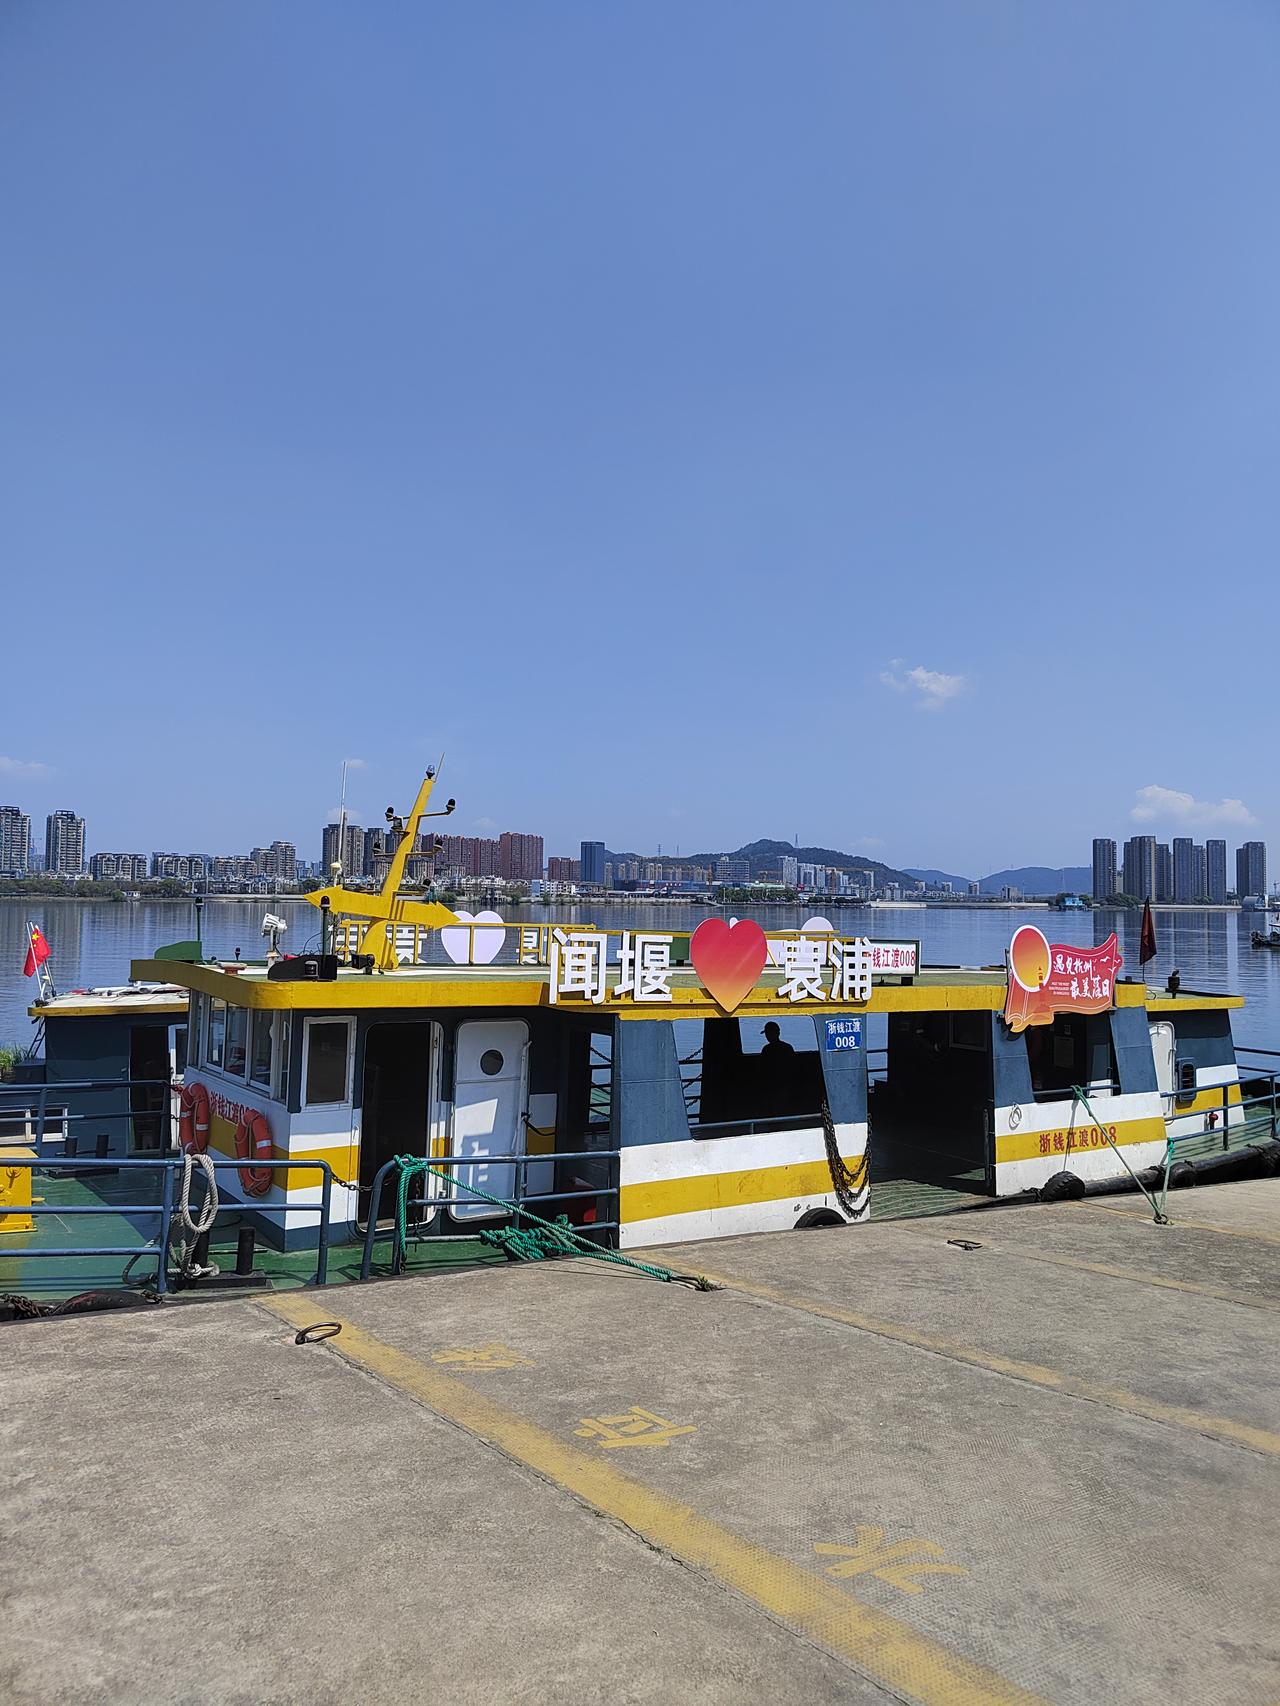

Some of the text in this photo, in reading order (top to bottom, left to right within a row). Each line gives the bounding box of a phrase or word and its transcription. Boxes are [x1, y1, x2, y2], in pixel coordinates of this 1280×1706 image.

[549, 927, 674, 1006] 闻堰
[778, 936, 872, 1001] 袁浦
[863, 948, 916, 968] 钱江渡008
[1052, 953, 1093, 980] 遇见杭州
[1070, 975, 1110, 1000] 最美落日
[828, 1021, 861, 1034] 浙钱江渡
[836, 1037, 856, 1047] 008
